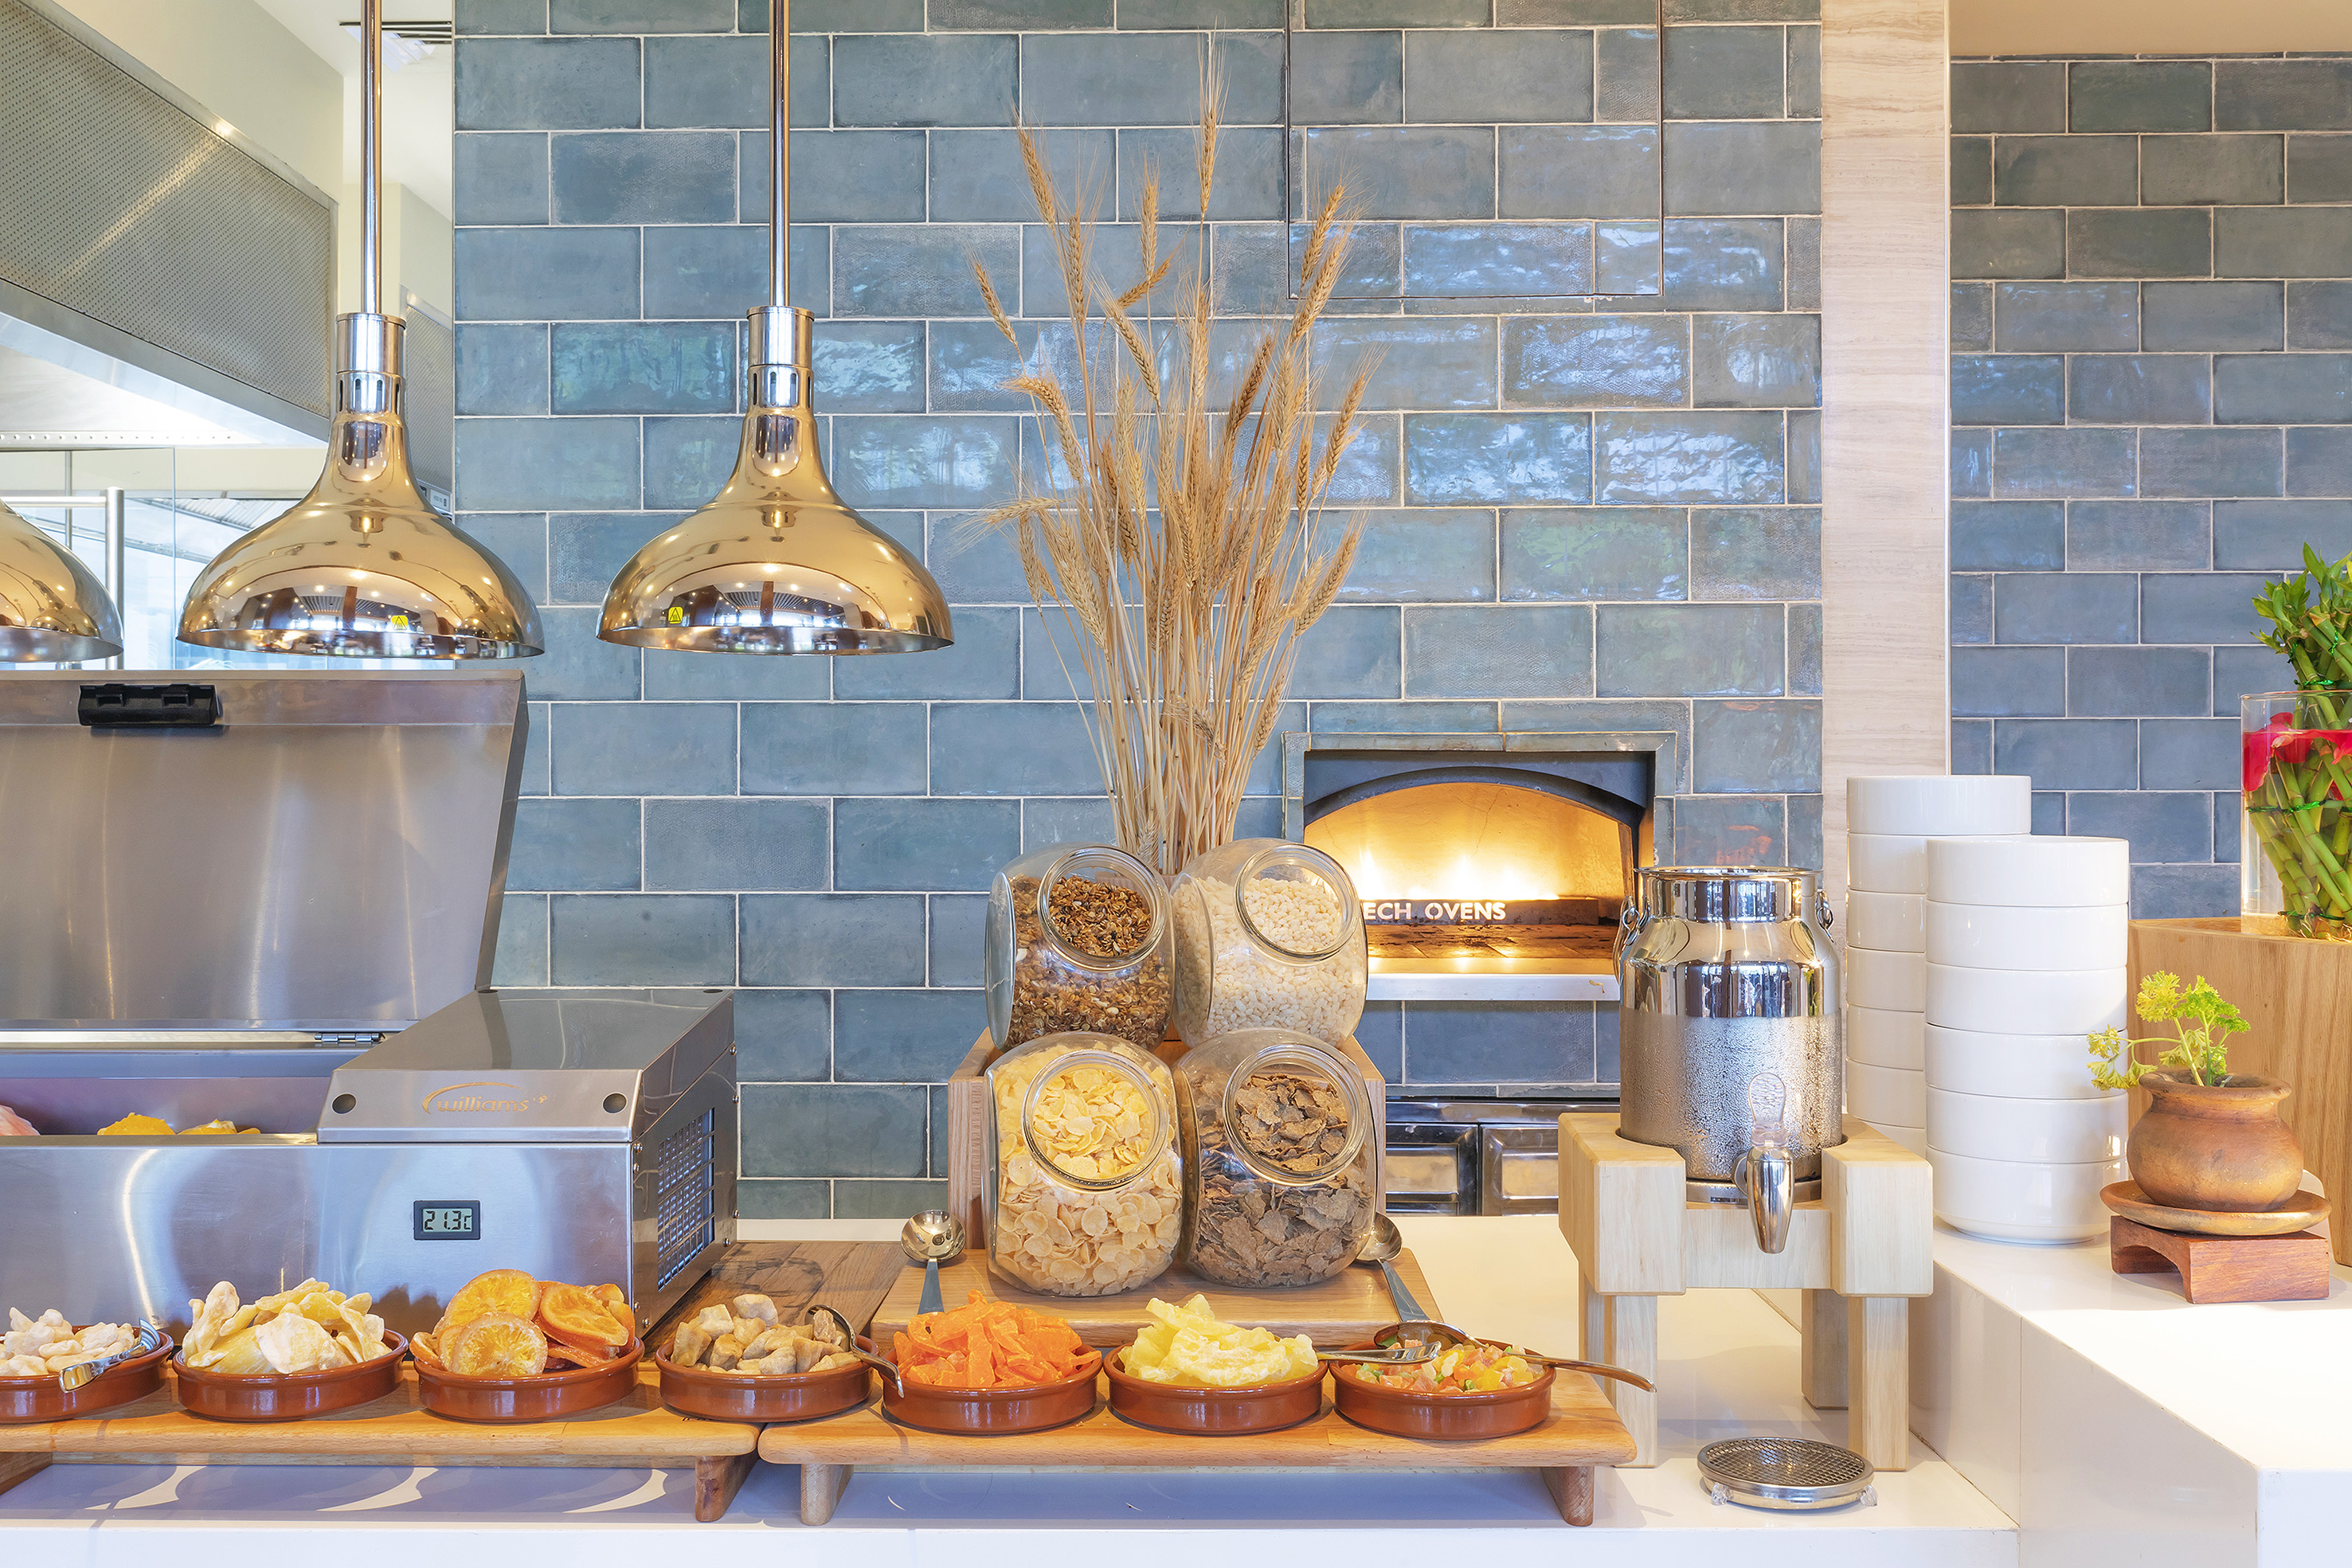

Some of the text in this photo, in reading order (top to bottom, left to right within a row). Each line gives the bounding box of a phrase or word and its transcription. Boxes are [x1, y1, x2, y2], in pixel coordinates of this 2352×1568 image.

[1360, 901, 1506, 921] ECH OVENS
[436, 1097, 530, 1112] williams
